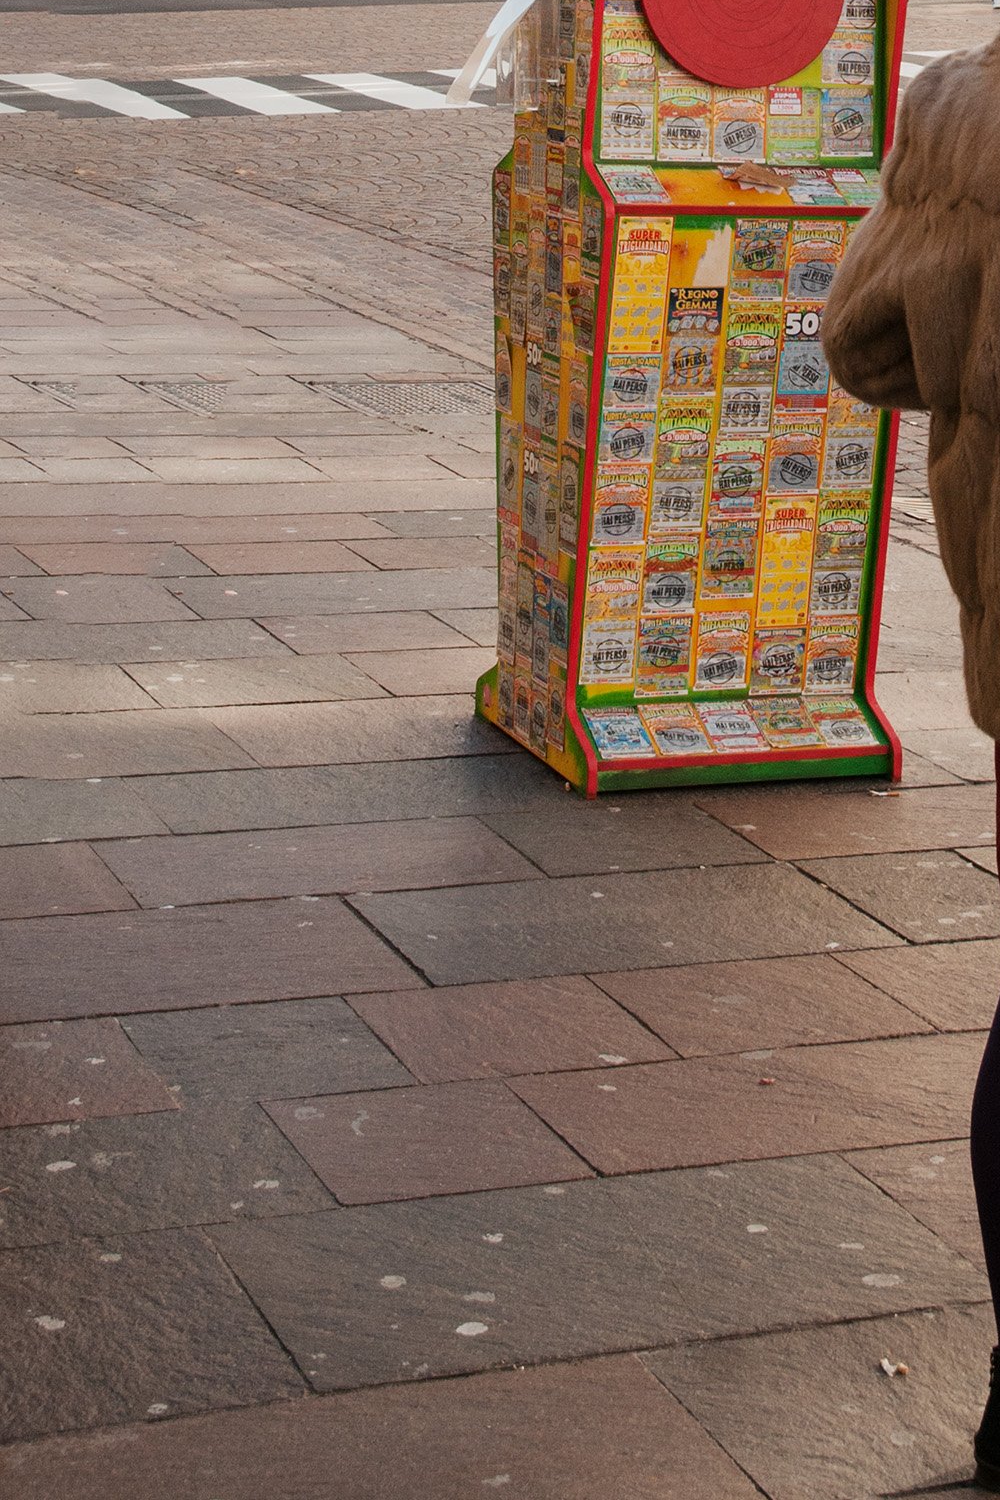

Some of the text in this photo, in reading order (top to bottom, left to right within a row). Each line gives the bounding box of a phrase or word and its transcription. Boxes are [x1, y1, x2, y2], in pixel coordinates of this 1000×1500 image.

[837, 63, 871, 74] HAI PERSO
[629, 229, 662, 241] SUPER
[619, 239, 670, 255] TRIGLIARDARIO
[677, 288, 719, 300] REGNO
[675, 300, 718, 310] GEMME
[667, 408, 706, 419] MAXI
[775, 508, 806, 518] SUPER
[766, 518, 814, 533] TRIGLIARDARIO
[592, 649, 627, 663] HAI PERSO
[703, 660, 738, 679] HAI PERSO
